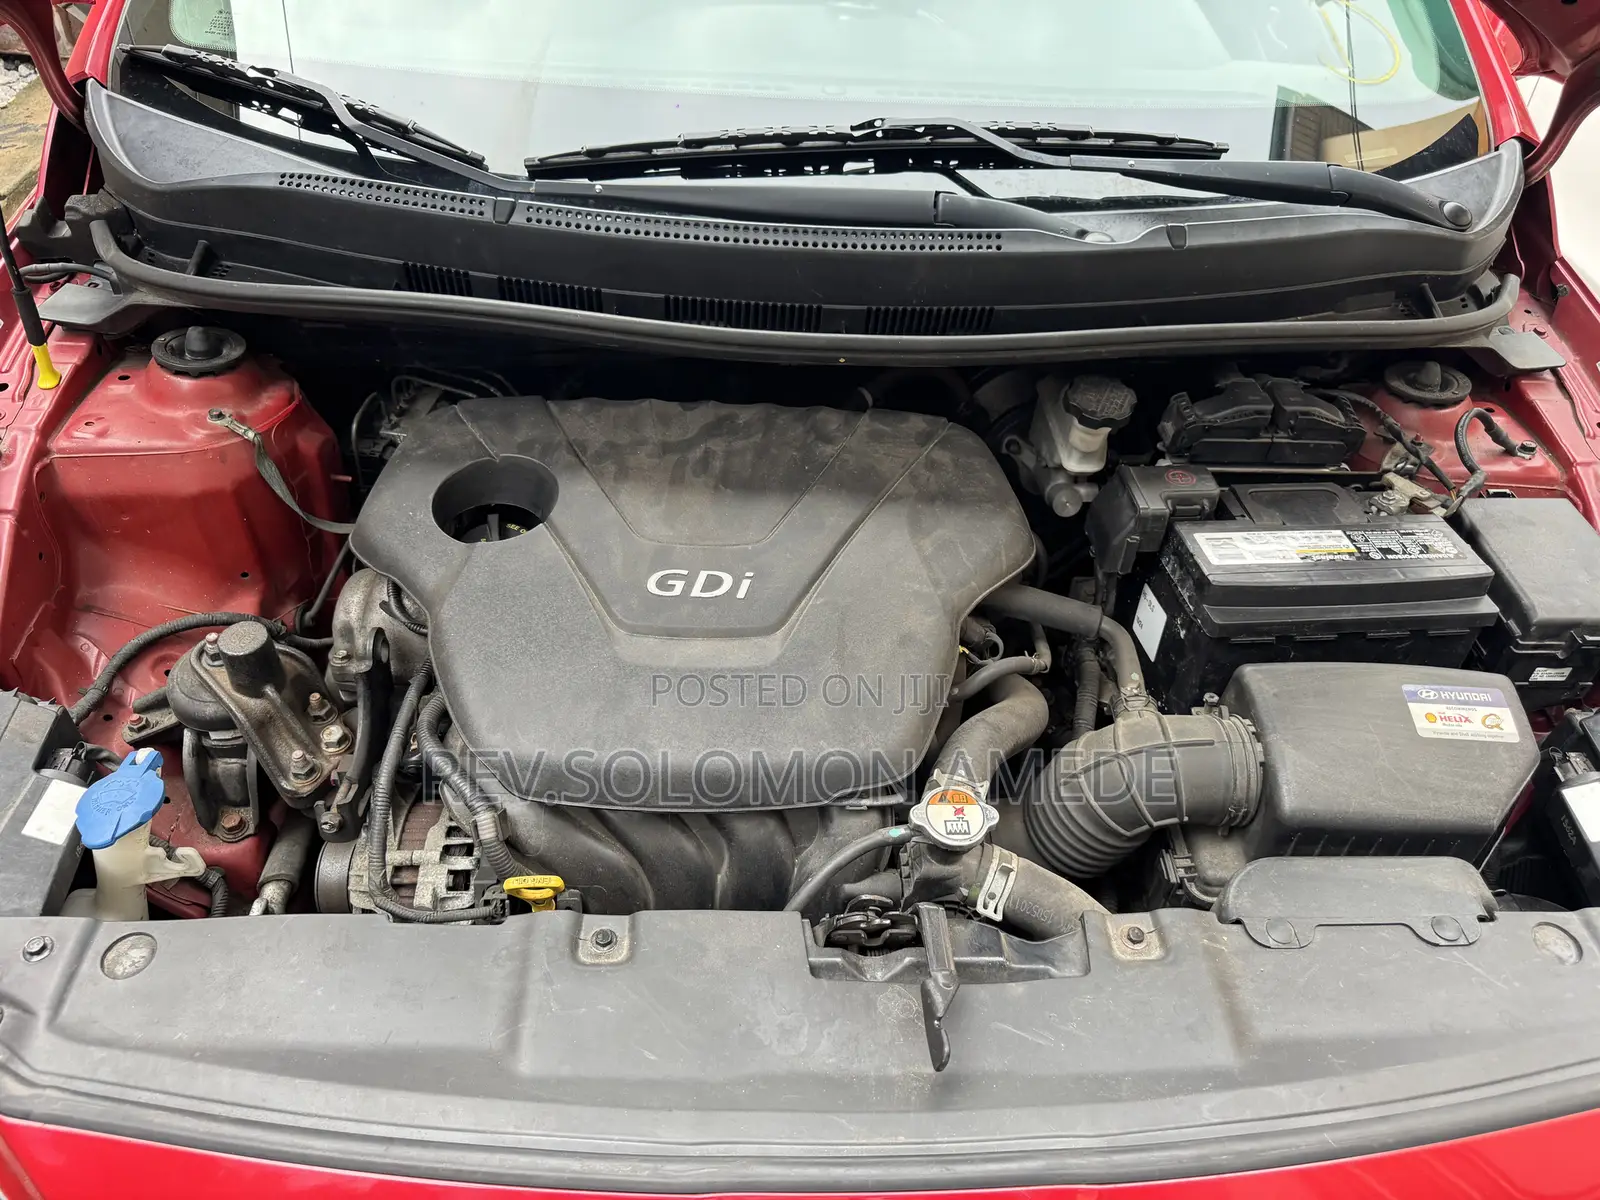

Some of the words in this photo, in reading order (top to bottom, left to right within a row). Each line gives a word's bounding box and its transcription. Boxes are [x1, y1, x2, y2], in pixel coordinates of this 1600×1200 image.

[646, 569, 754, 600] GDi
[1440, 690, 1492, 702] HYUNDAI
[1439, 713, 1474, 724] HELIX
